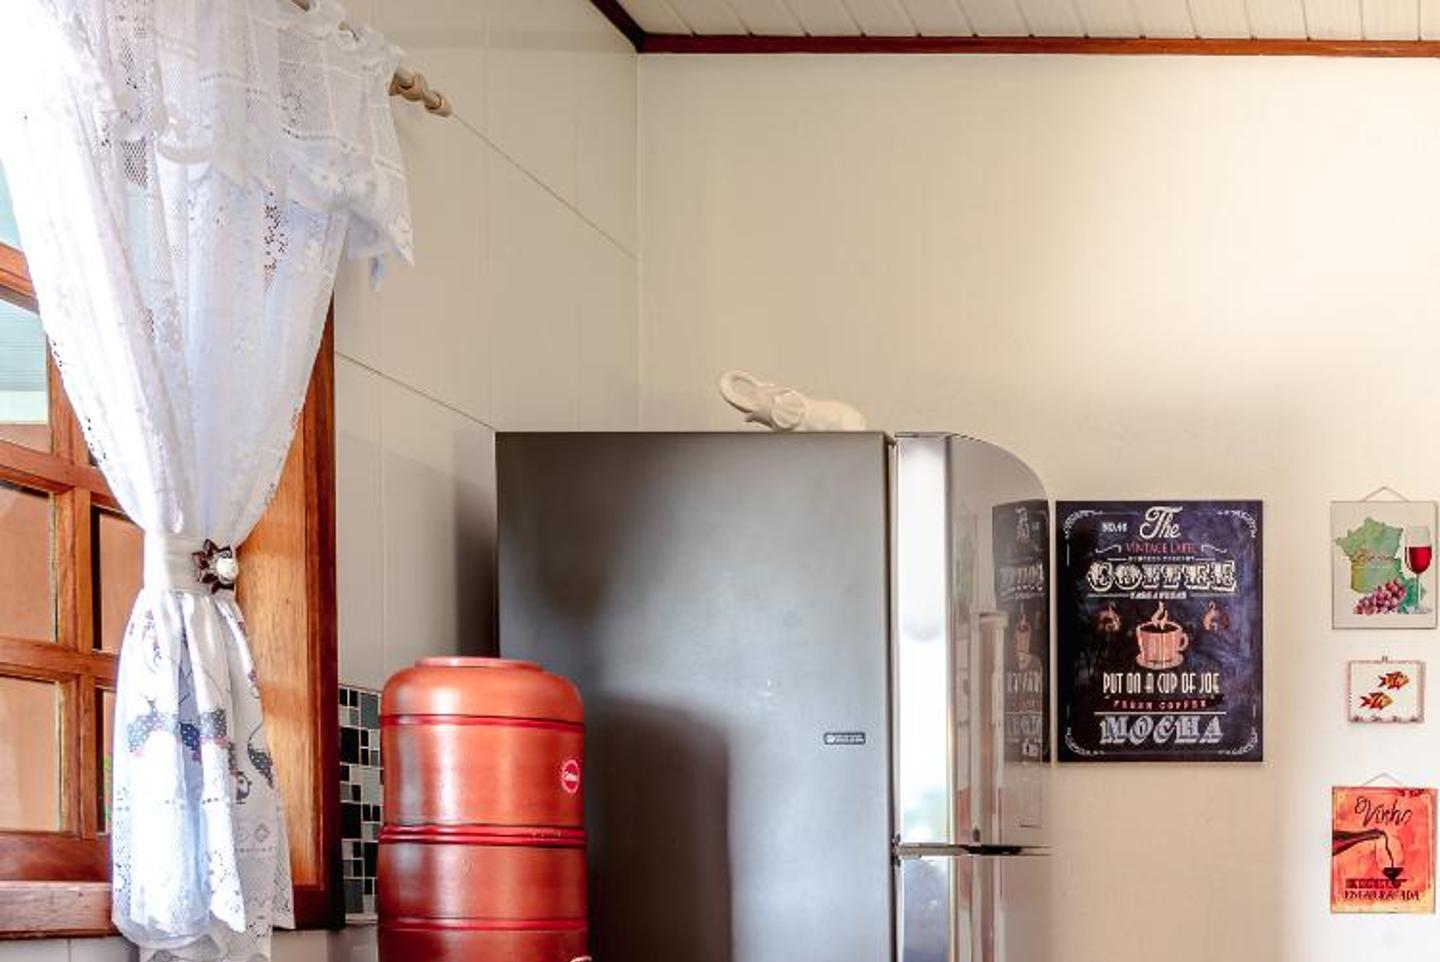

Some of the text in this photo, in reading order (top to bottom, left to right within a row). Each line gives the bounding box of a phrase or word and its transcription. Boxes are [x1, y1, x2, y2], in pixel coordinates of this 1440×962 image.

[1140, 506, 1183, 539] The
[1125, 543, 1168, 554] VINTAGE
[1086, 561, 1237, 592] COFFEE
[1102, 672, 1124, 694] PUT
[1126, 672, 1142, 694] ON
[1157, 672, 1179, 694] CUP
[1181, 672, 1197, 694] OF
[1199, 672, 1220, 694] JOE
[1099, 715, 1224, 745] MOCHA
